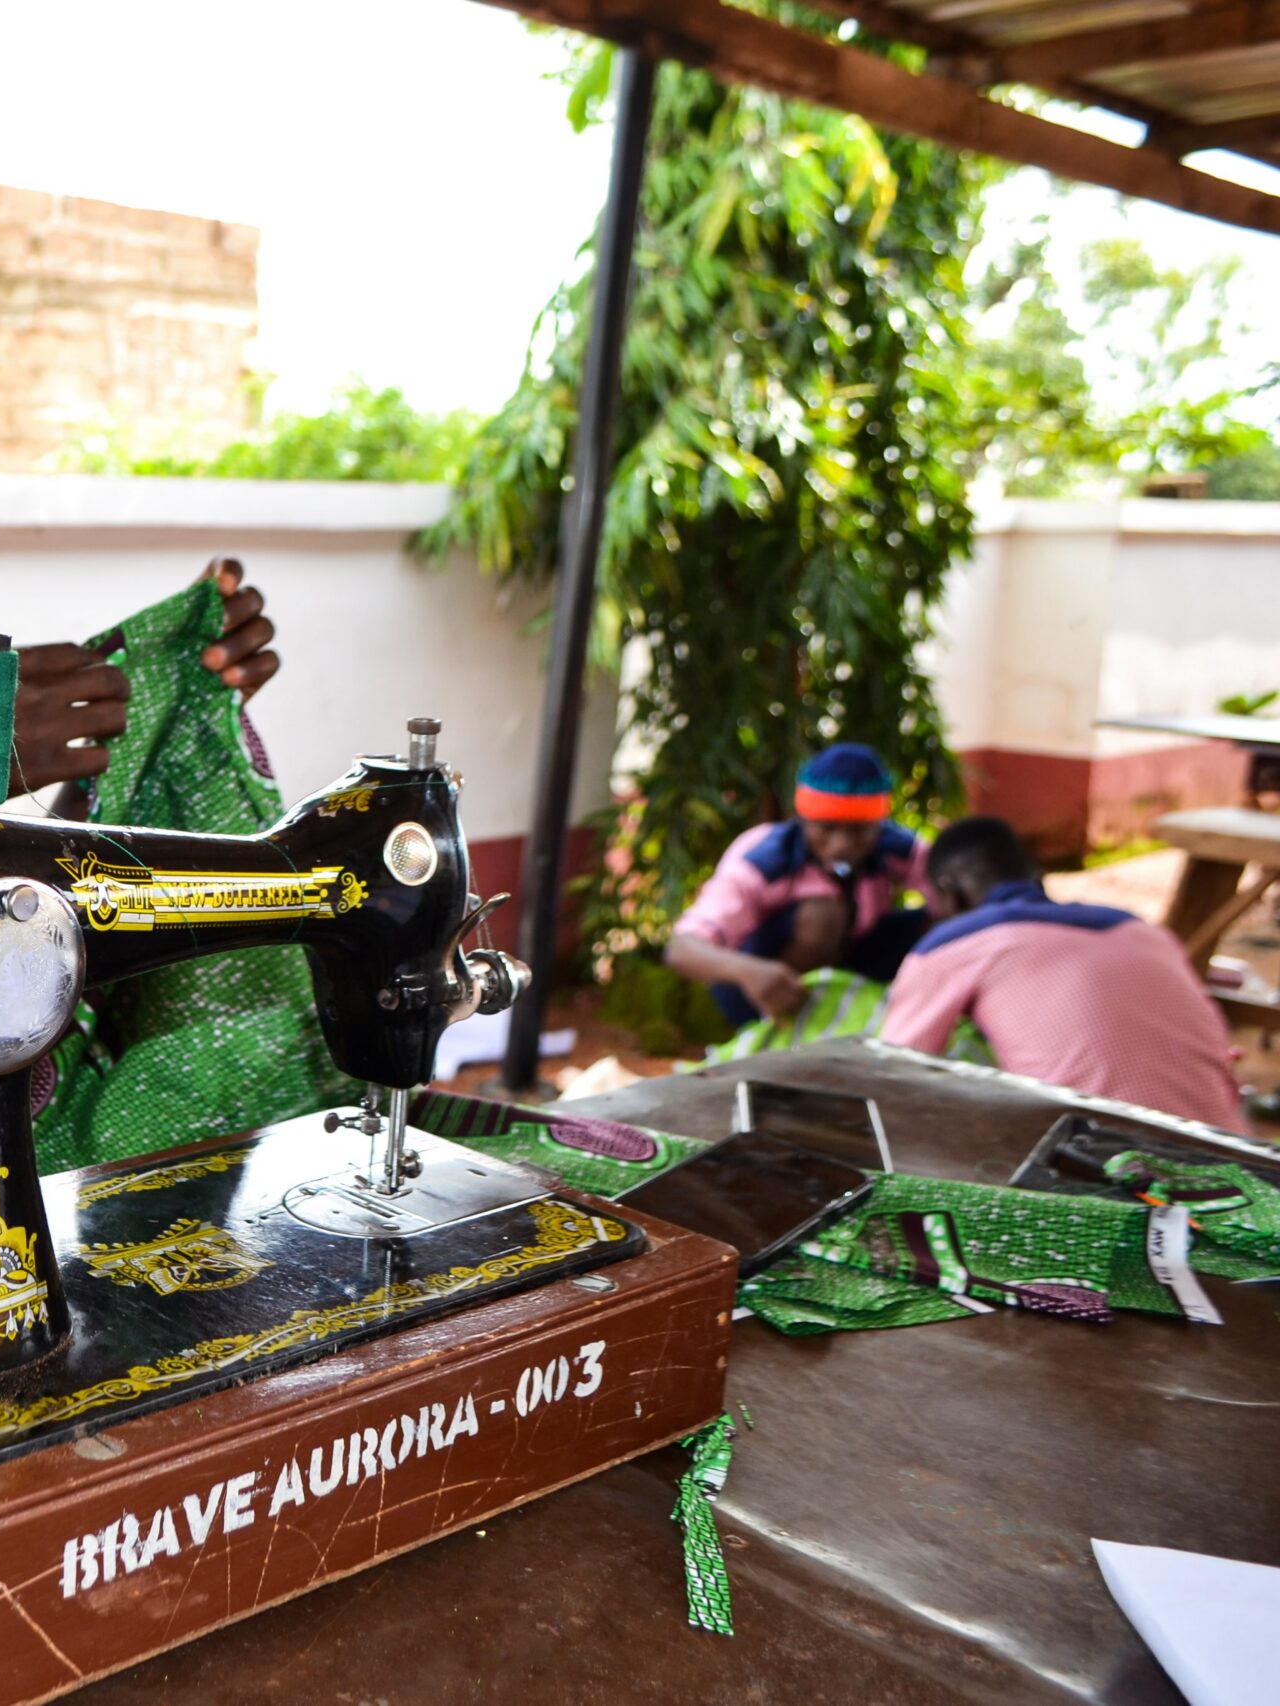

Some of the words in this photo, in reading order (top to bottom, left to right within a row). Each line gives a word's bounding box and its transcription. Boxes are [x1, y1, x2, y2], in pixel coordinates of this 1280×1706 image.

[167, 882, 207, 908] NEW
[59, 1471, 256, 1599] BRAVE
[268, 1392, 479, 1517] AURORA
